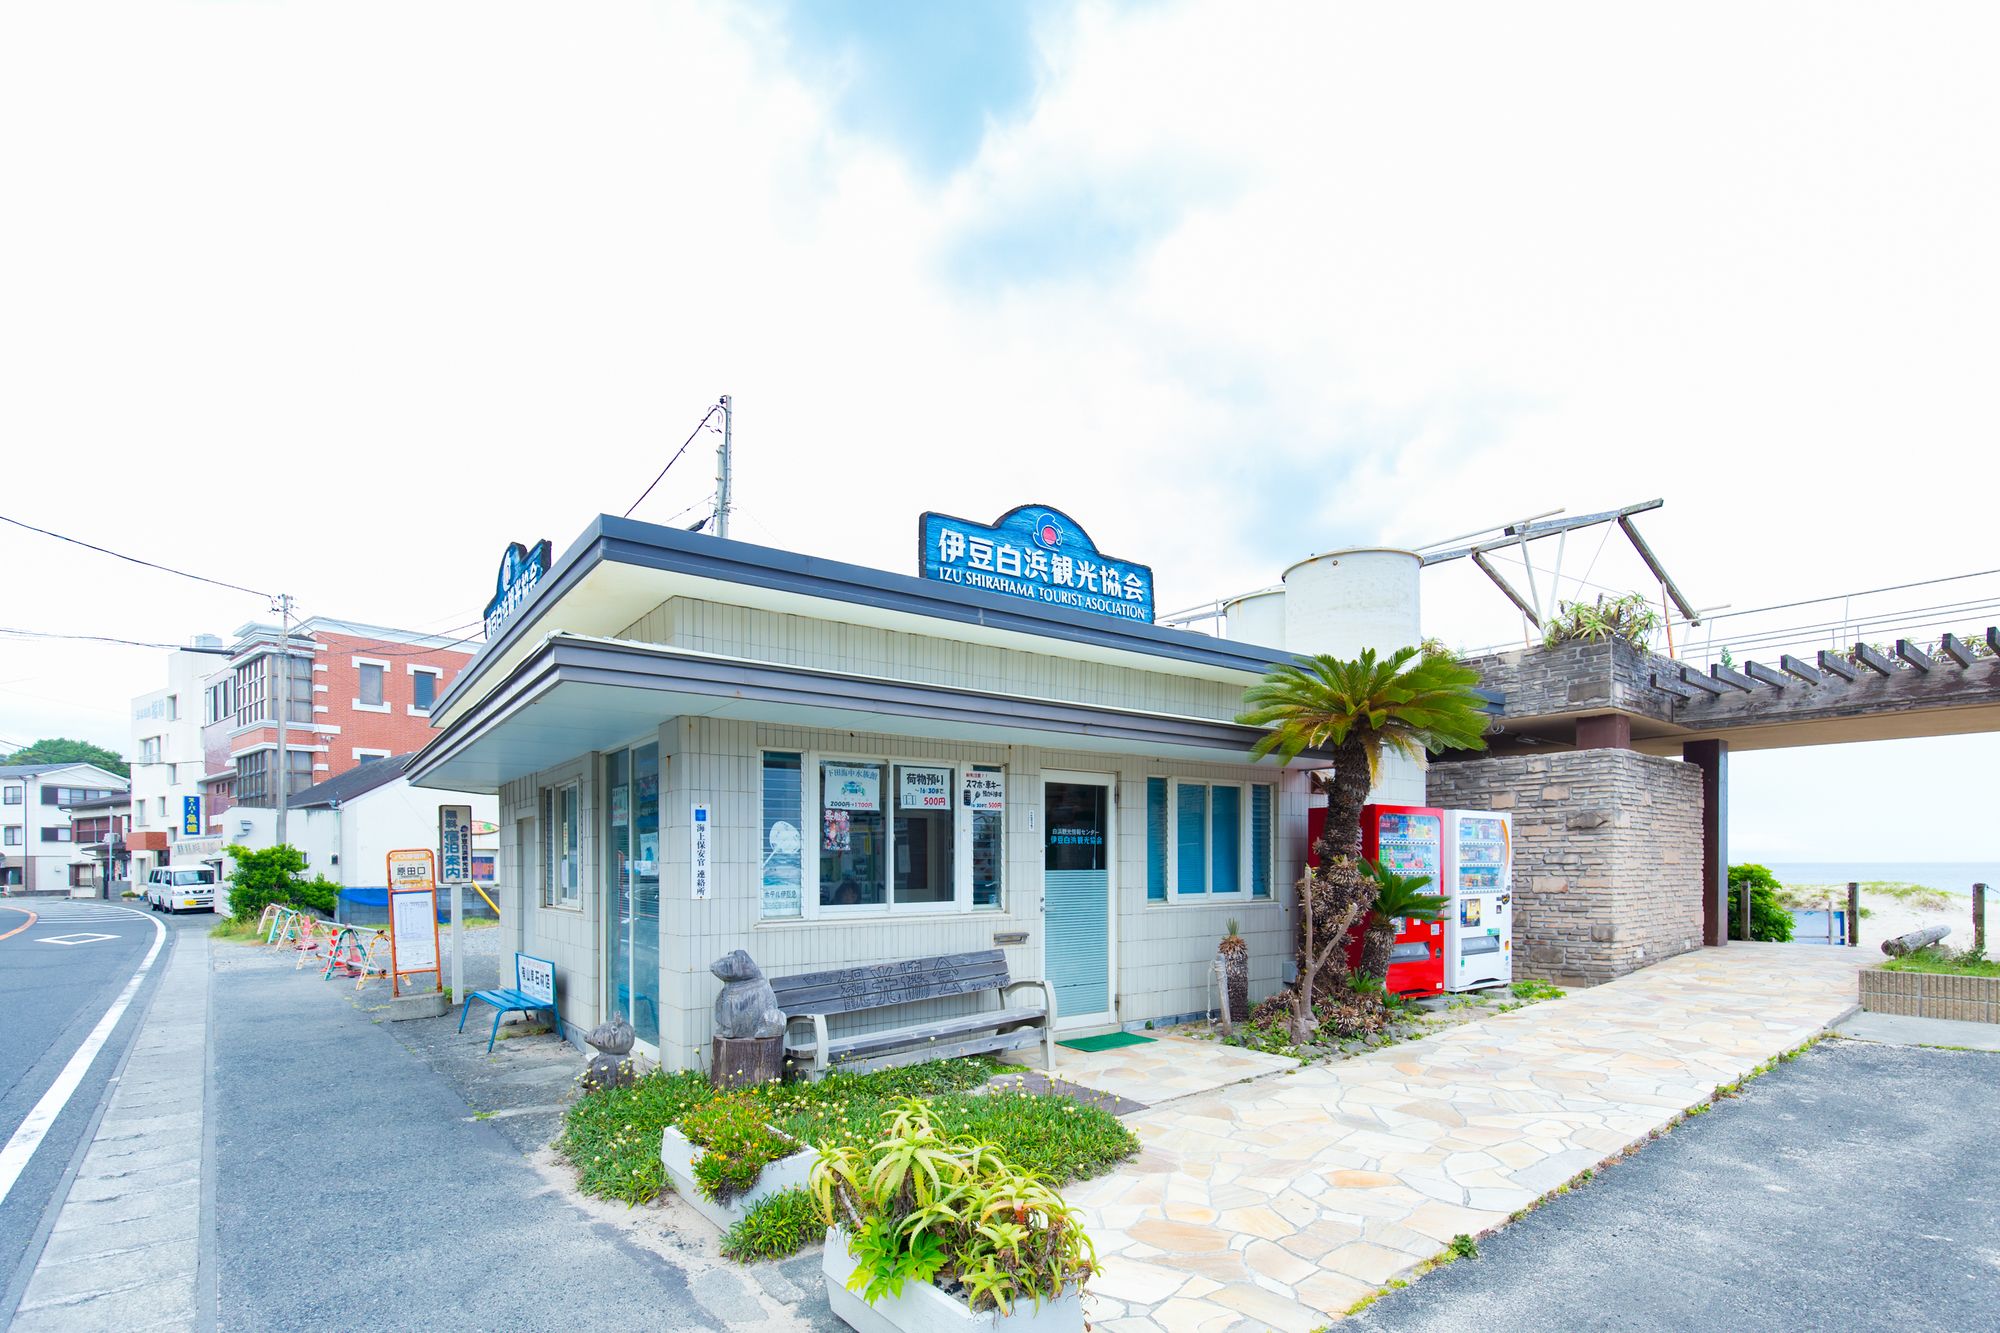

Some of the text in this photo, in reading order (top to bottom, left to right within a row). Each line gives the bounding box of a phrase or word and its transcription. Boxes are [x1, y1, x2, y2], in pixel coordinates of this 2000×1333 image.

[938, 527, 1144, 601] 伊豆白浜観光協会
[939, 567, 1145, 620] IZU SHIRAHAMA TOURIST ASOCIATION
[906, 773, 944, 786] 荷物預り
[923, 796, 946, 806] 500円
[397, 866, 426, 875] 原田口
[444, 809, 461, 879] 無料宿泊案内
[696, 823, 706, 896] 海上保安官 連絡所
[839, 956, 964, 1011] 観光協会
